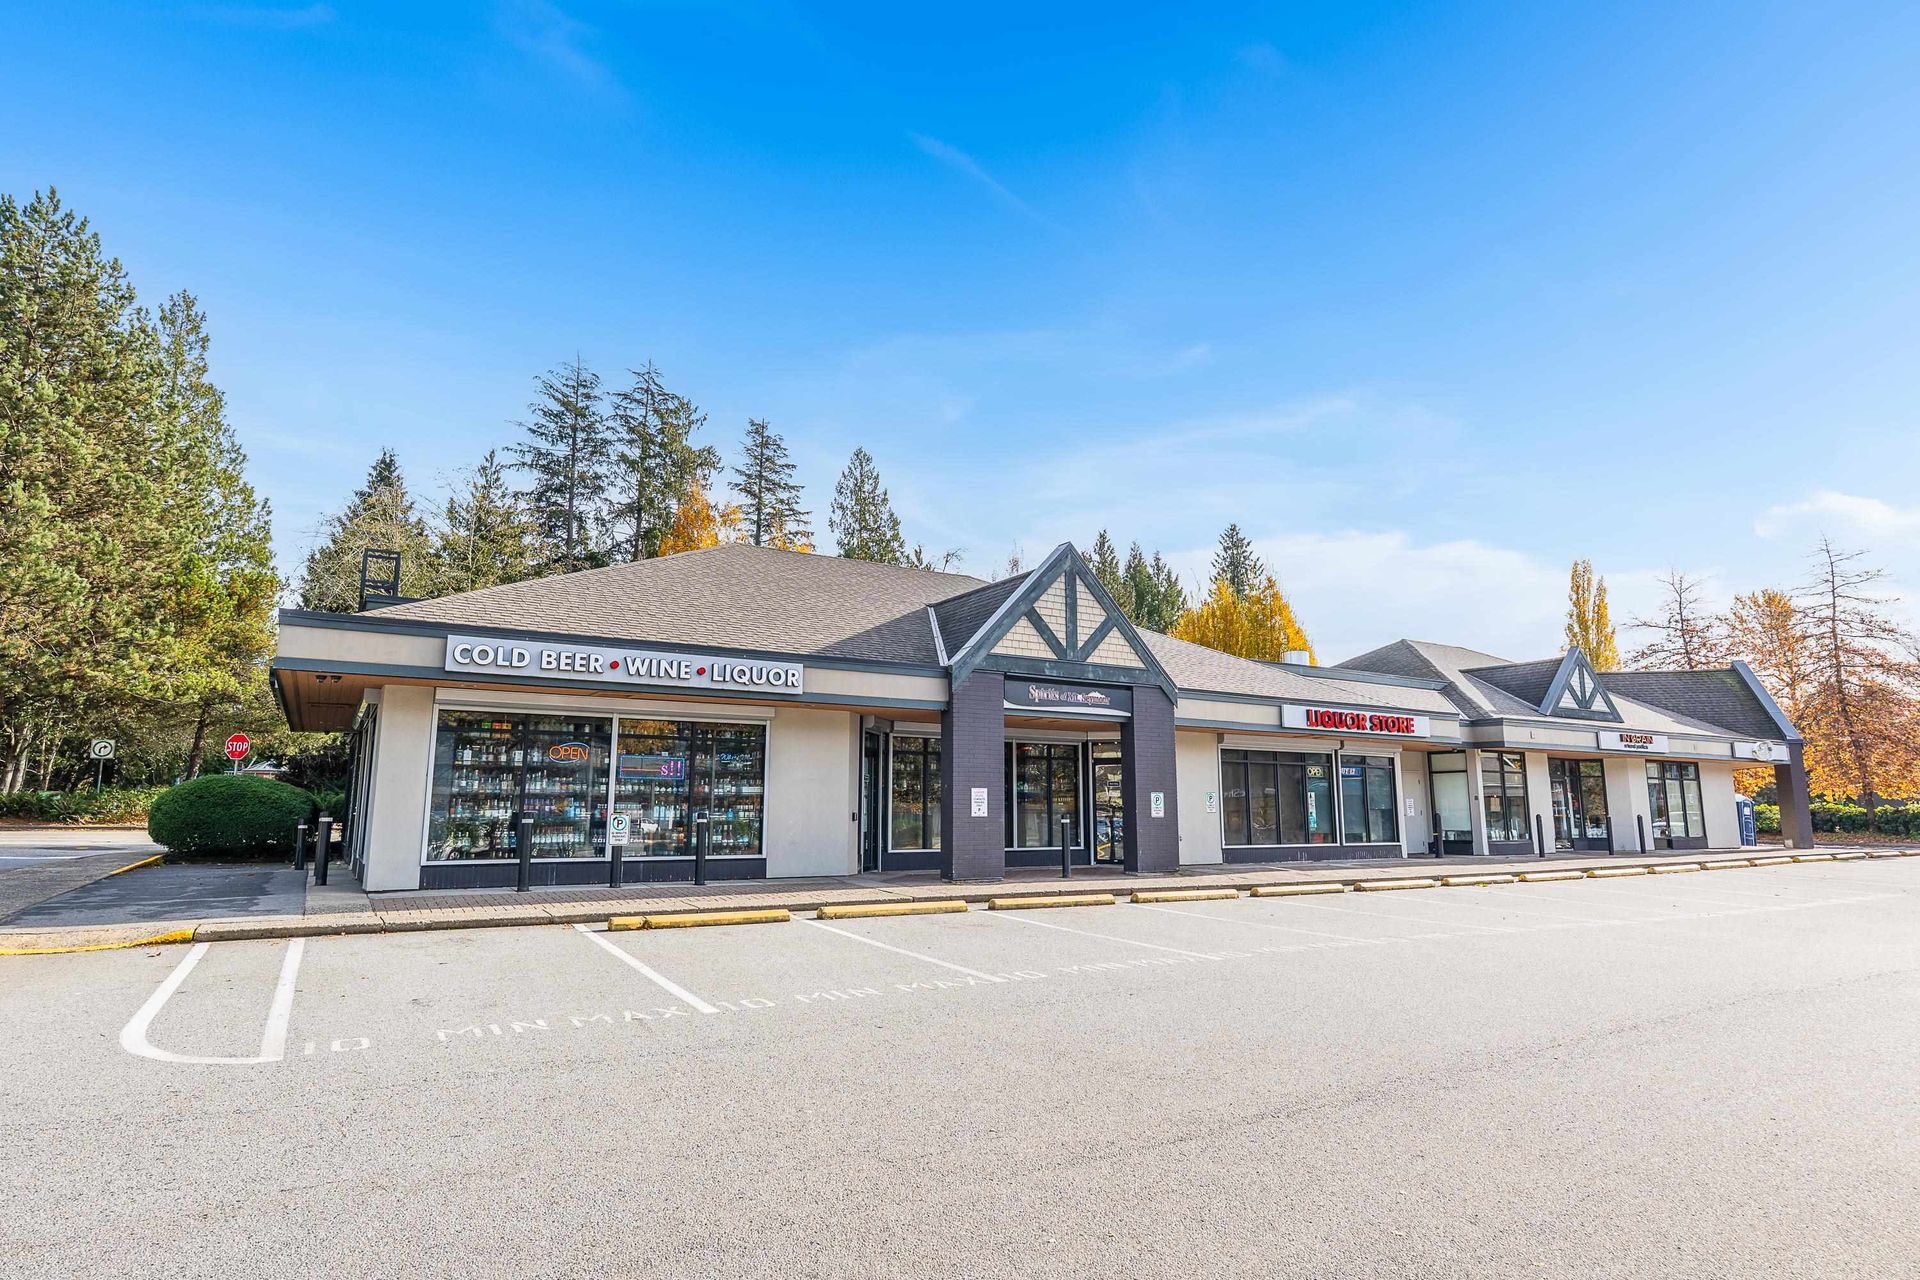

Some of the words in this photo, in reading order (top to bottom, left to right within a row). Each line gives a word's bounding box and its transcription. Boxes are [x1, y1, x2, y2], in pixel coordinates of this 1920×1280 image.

[453, 643, 531, 668] COLD
[540, 650, 604, 674] BEER
[624, 656, 692, 679] WINE
[711, 663, 800, 687] LIQUOR
[1029, 684, 1060, 702] Spirits
[1306, 708, 1368, 731] LIQUOR
[1369, 714, 1415, 734] STORE
[227, 741, 248, 752] STOP
[549, 745, 589, 760] OPEN
[713, 997, 776, 1011] 10
[793, 986, 885, 1003] MIN
[895, 975, 992, 993] MAX
[304, 1036, 371, 1055] 10
[436, 1019, 552, 1041] MIN
[568, 1005, 692, 1028] MAX
